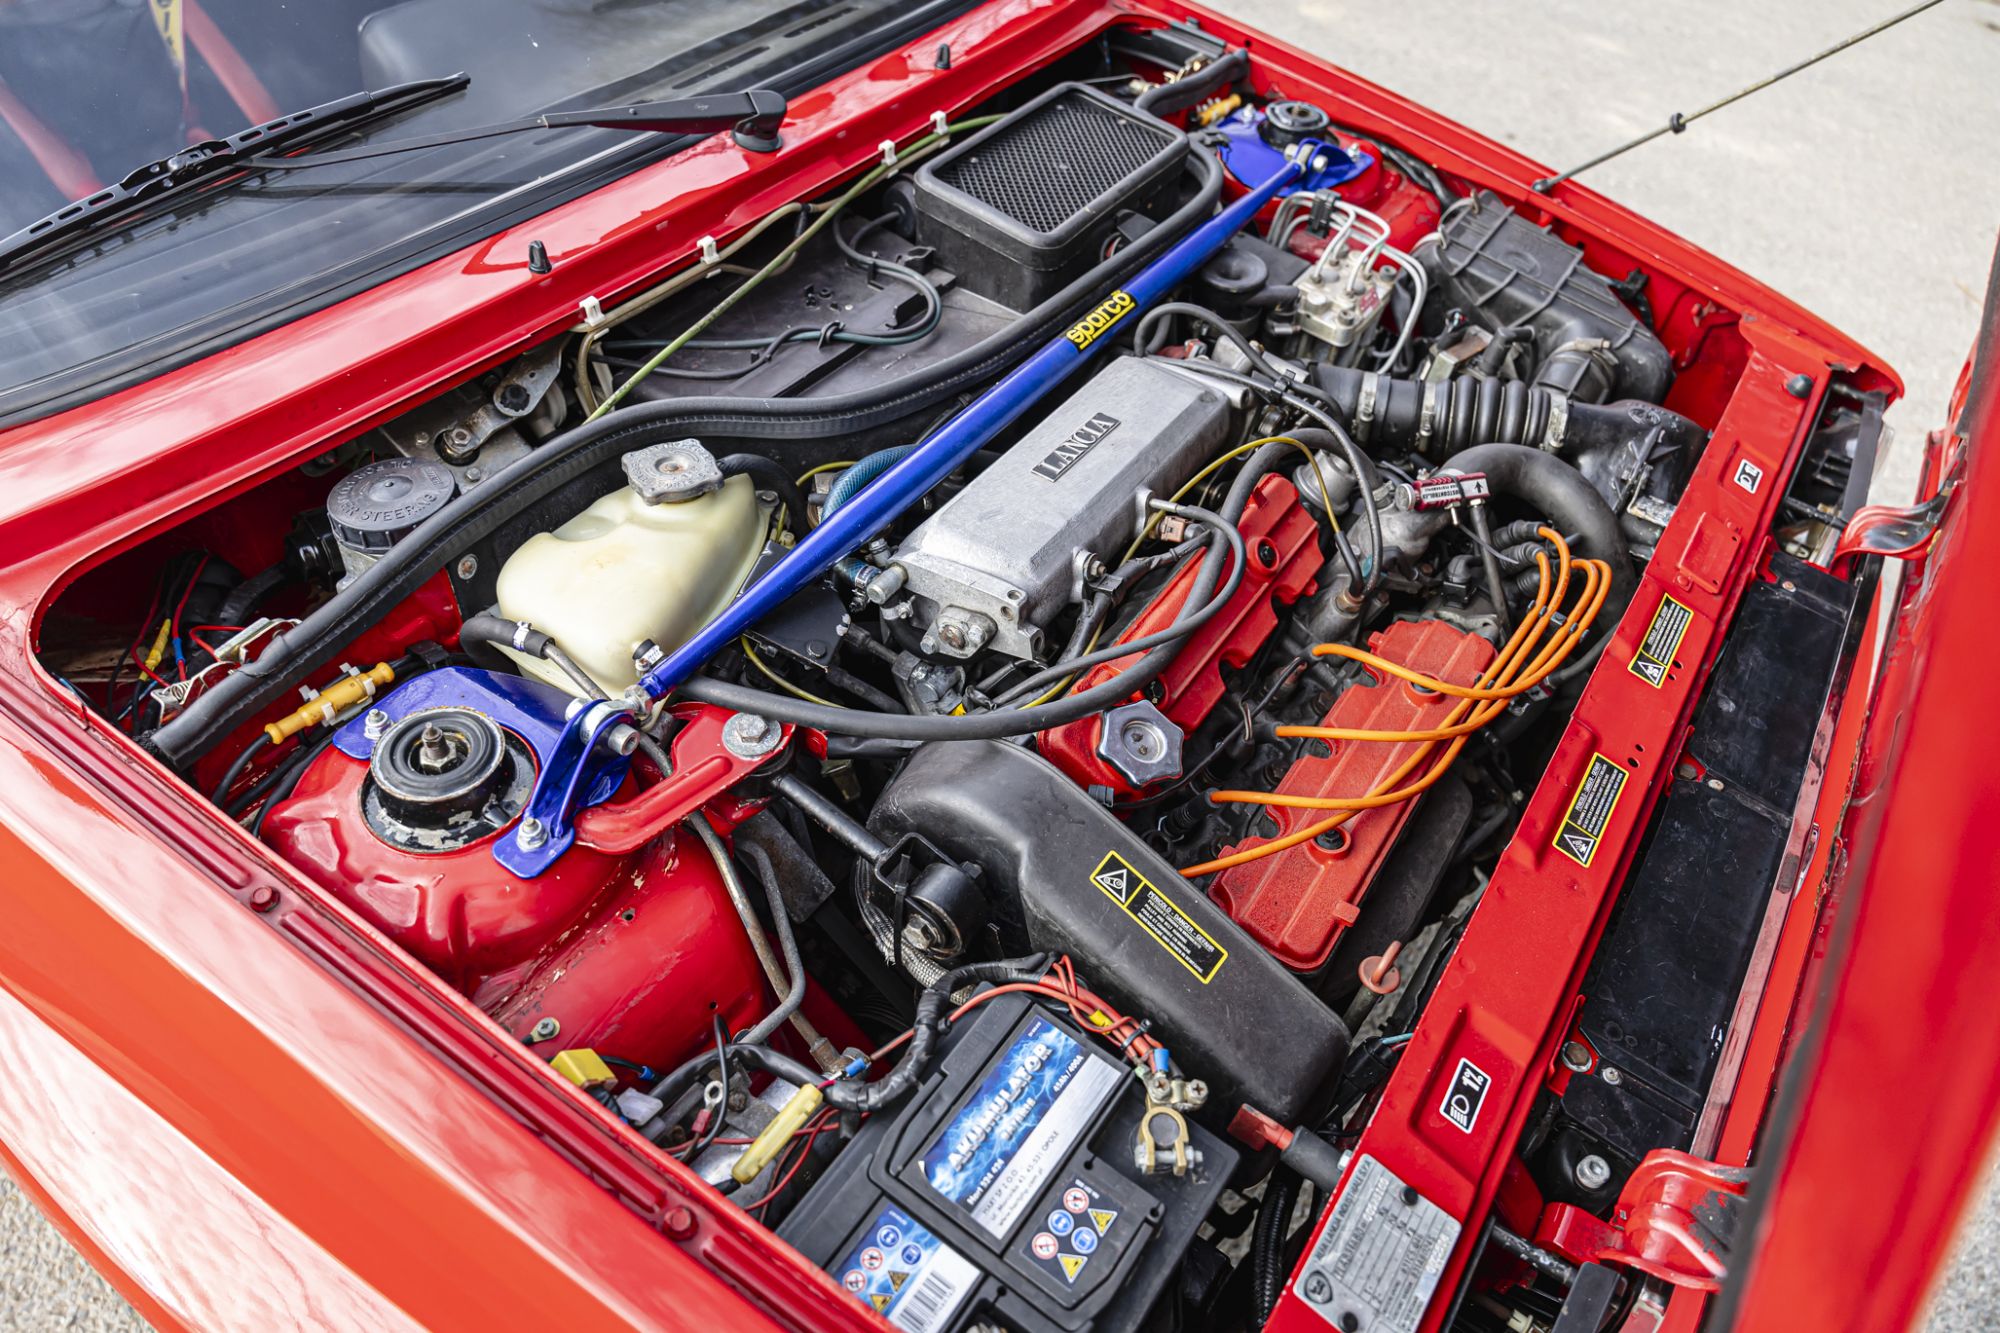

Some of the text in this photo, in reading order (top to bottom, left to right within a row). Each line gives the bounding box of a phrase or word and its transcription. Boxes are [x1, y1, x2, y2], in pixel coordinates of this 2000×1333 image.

[1066, 291, 1132, 346] sparco
[1041, 420, 1114, 472] LANCIA
[360, 494, 438, 522] STEERING
[1148, 890, 1172, 914] PERICOLO
[1173, 912, 1194, 933] DANGER
[1195, 932, 1214, 952] GEFAHR
[1462, 1068, 1484, 1092] 1%
[948, 1043, 1052, 1172] AKUMULATOR
[1040, 1129, 1060, 1152] OPOLE
[965, 1184, 985, 1207] Hart
[989, 1156, 1005, 1175] 424
[1322, 1215, 1343, 1244] LANCIA
